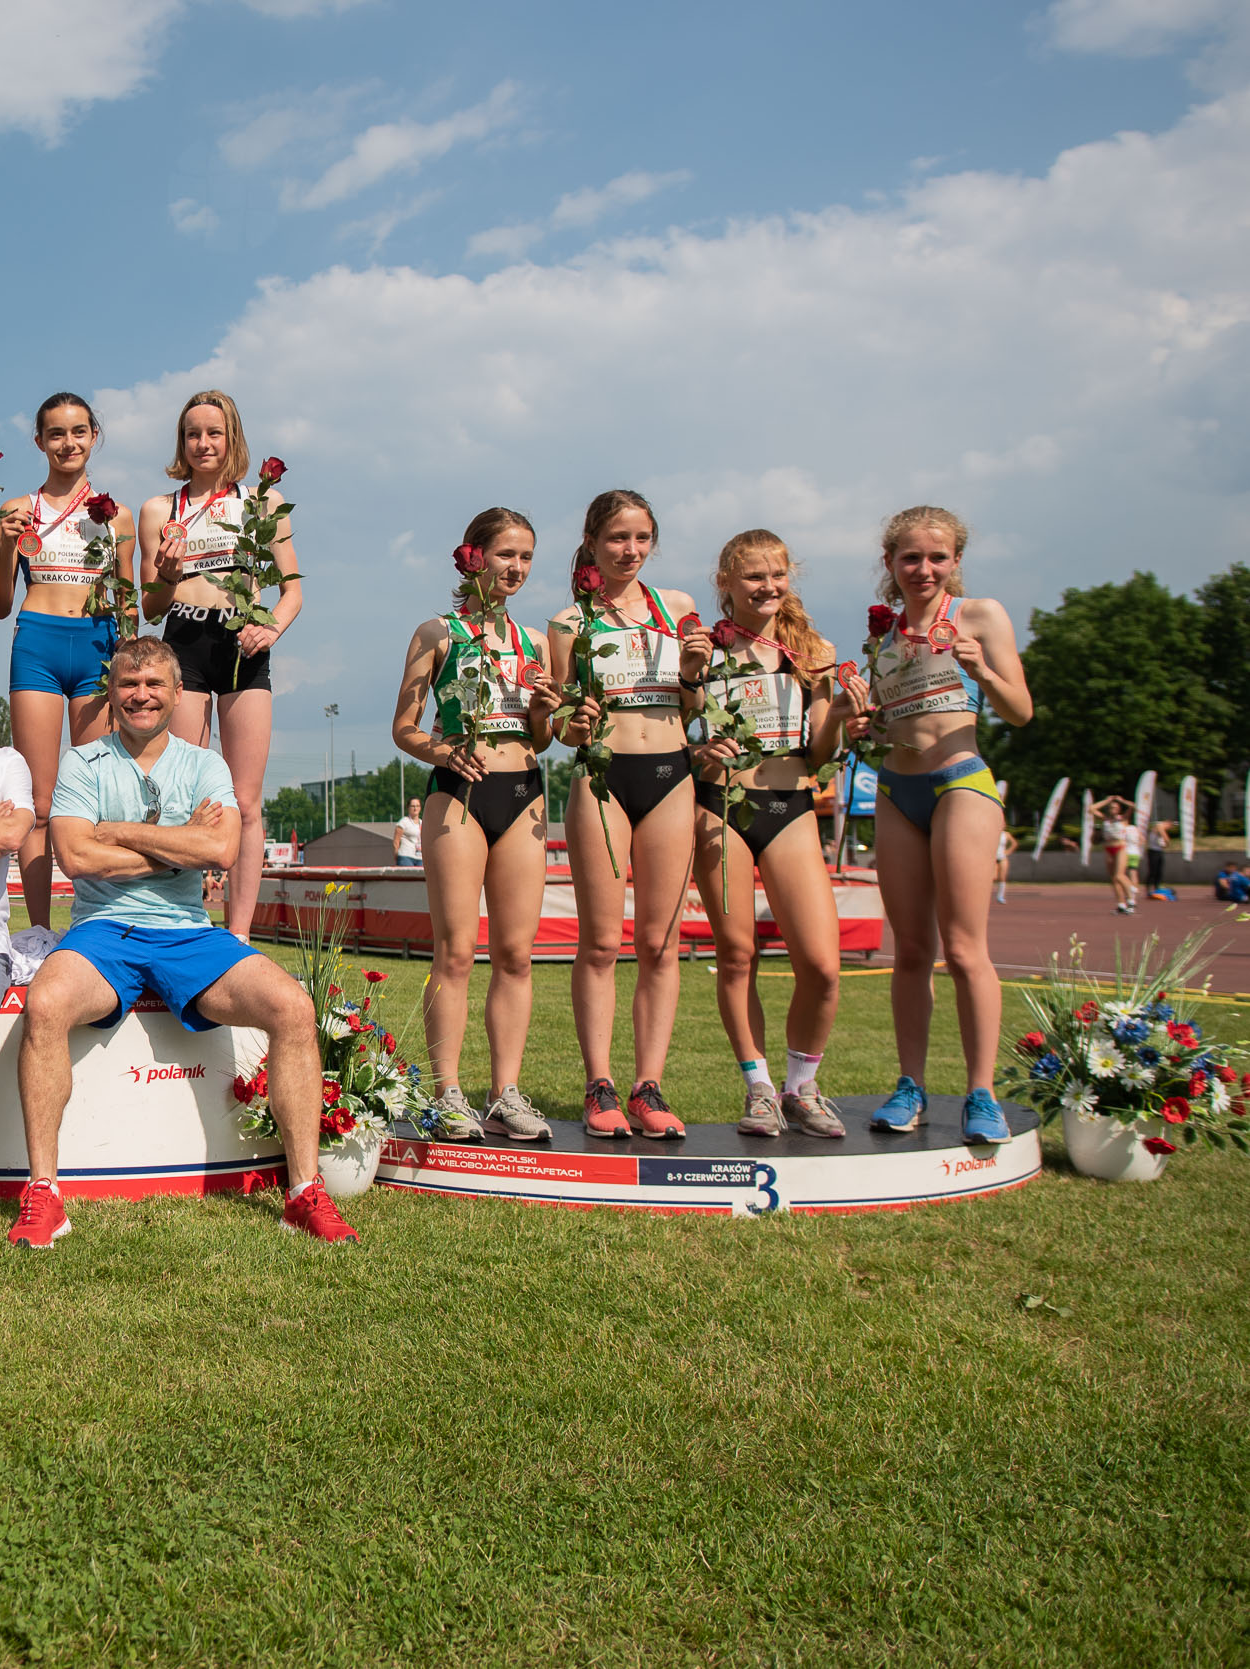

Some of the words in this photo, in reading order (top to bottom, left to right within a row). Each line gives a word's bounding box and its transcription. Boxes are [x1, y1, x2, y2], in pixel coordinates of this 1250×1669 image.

[188, 539, 206, 552] 00
[194, 556, 231, 570] KRAKÓW
[41, 573, 79, 583] KRAKÓW
[168, 602, 209, 621] PRO
[606, 672, 625, 686] 00
[618, 694, 654, 705] RAKÓW
[655, 694, 671, 703] 2019
[882, 685, 901, 700] 100
[892, 701, 924, 717] KRAKÓW
[925, 695, 950, 708] 2019
[483, 719, 518, 731] AKÓW
[957, 761, 977, 775] PRO
[147, 1064, 206, 1084] polanik
[380, 1144, 419, 1164] ZLA
[427, 1148, 498, 1162] MISTRZOSTWA
[500, 1155, 537, 1165] POLSKI
[427, 1157, 436, 1166] W
[438, 1158, 511, 1173] WIELOBOJACH
[517, 1165, 583, 1178] SZTAFETACH
[711, 1163, 751, 1173] KRAKÓW
[667, 1173, 683, 1182] 8-9
[684, 1173, 727, 1182] CZERWCA
[730, 1173, 751, 1182] 2019
[745, 1163, 780, 1214] 3
